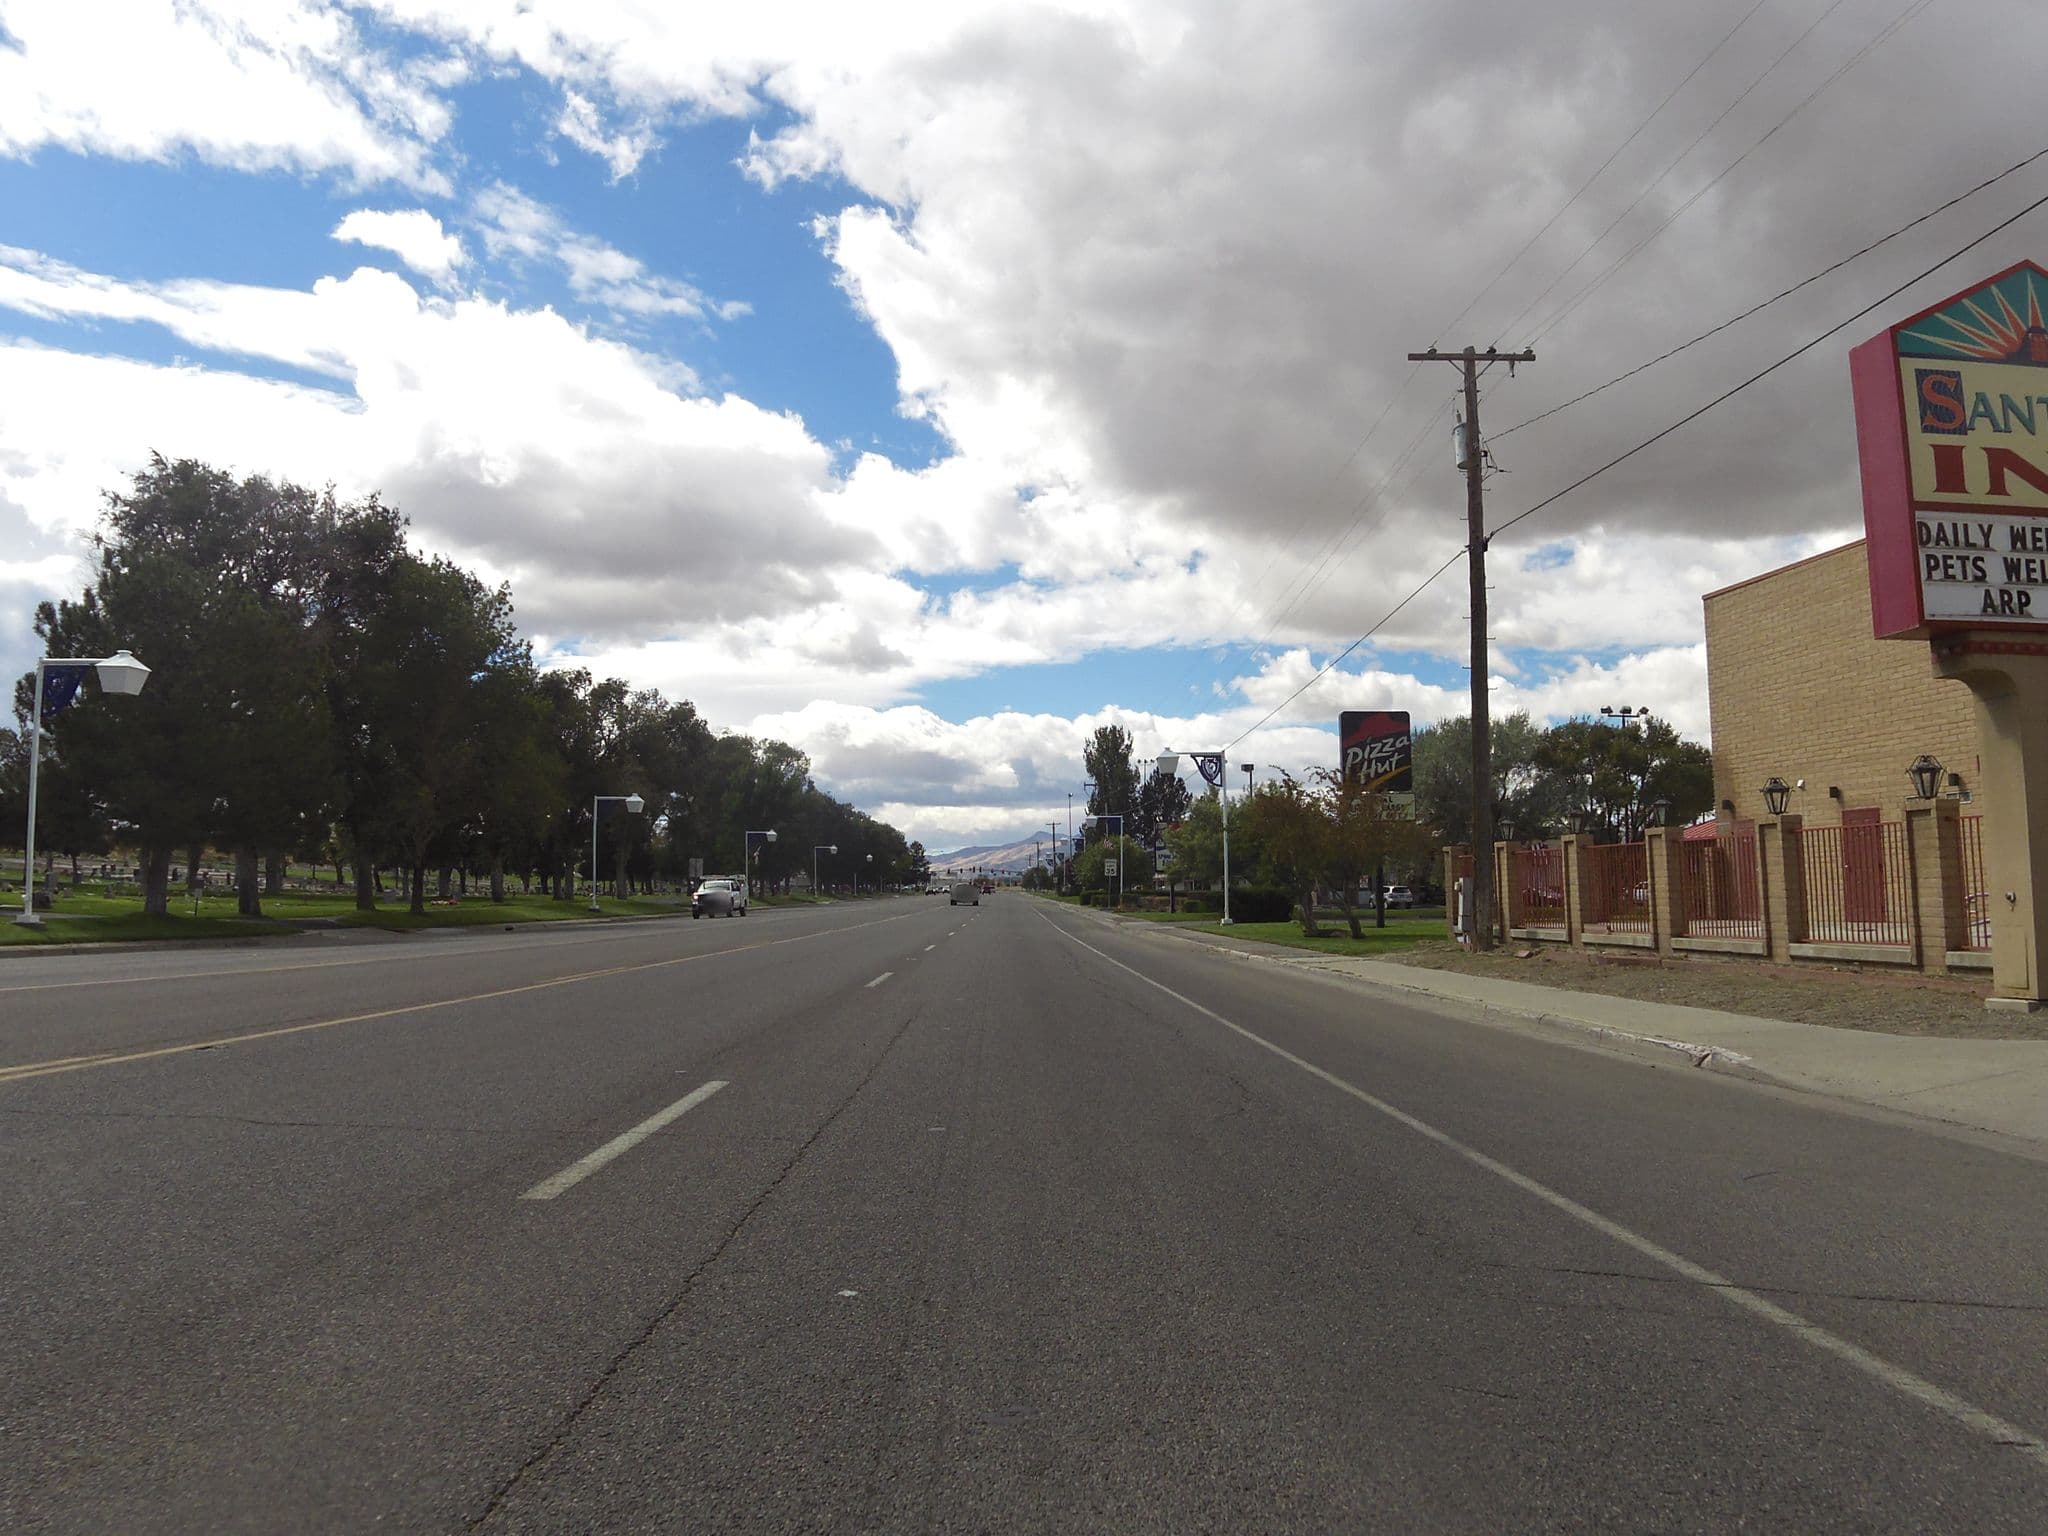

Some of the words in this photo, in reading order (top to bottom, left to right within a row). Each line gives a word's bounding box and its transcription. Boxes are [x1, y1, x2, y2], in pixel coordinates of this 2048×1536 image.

[1916, 520, 1993, 549] DAILY
[2009, 525, 2048, 552] WE
[1925, 553, 1987, 582] PETS
[1982, 588, 2031, 615] ARP
[1346, 735, 1410, 774] Pizza
[1358, 752, 1405, 784] Hut
